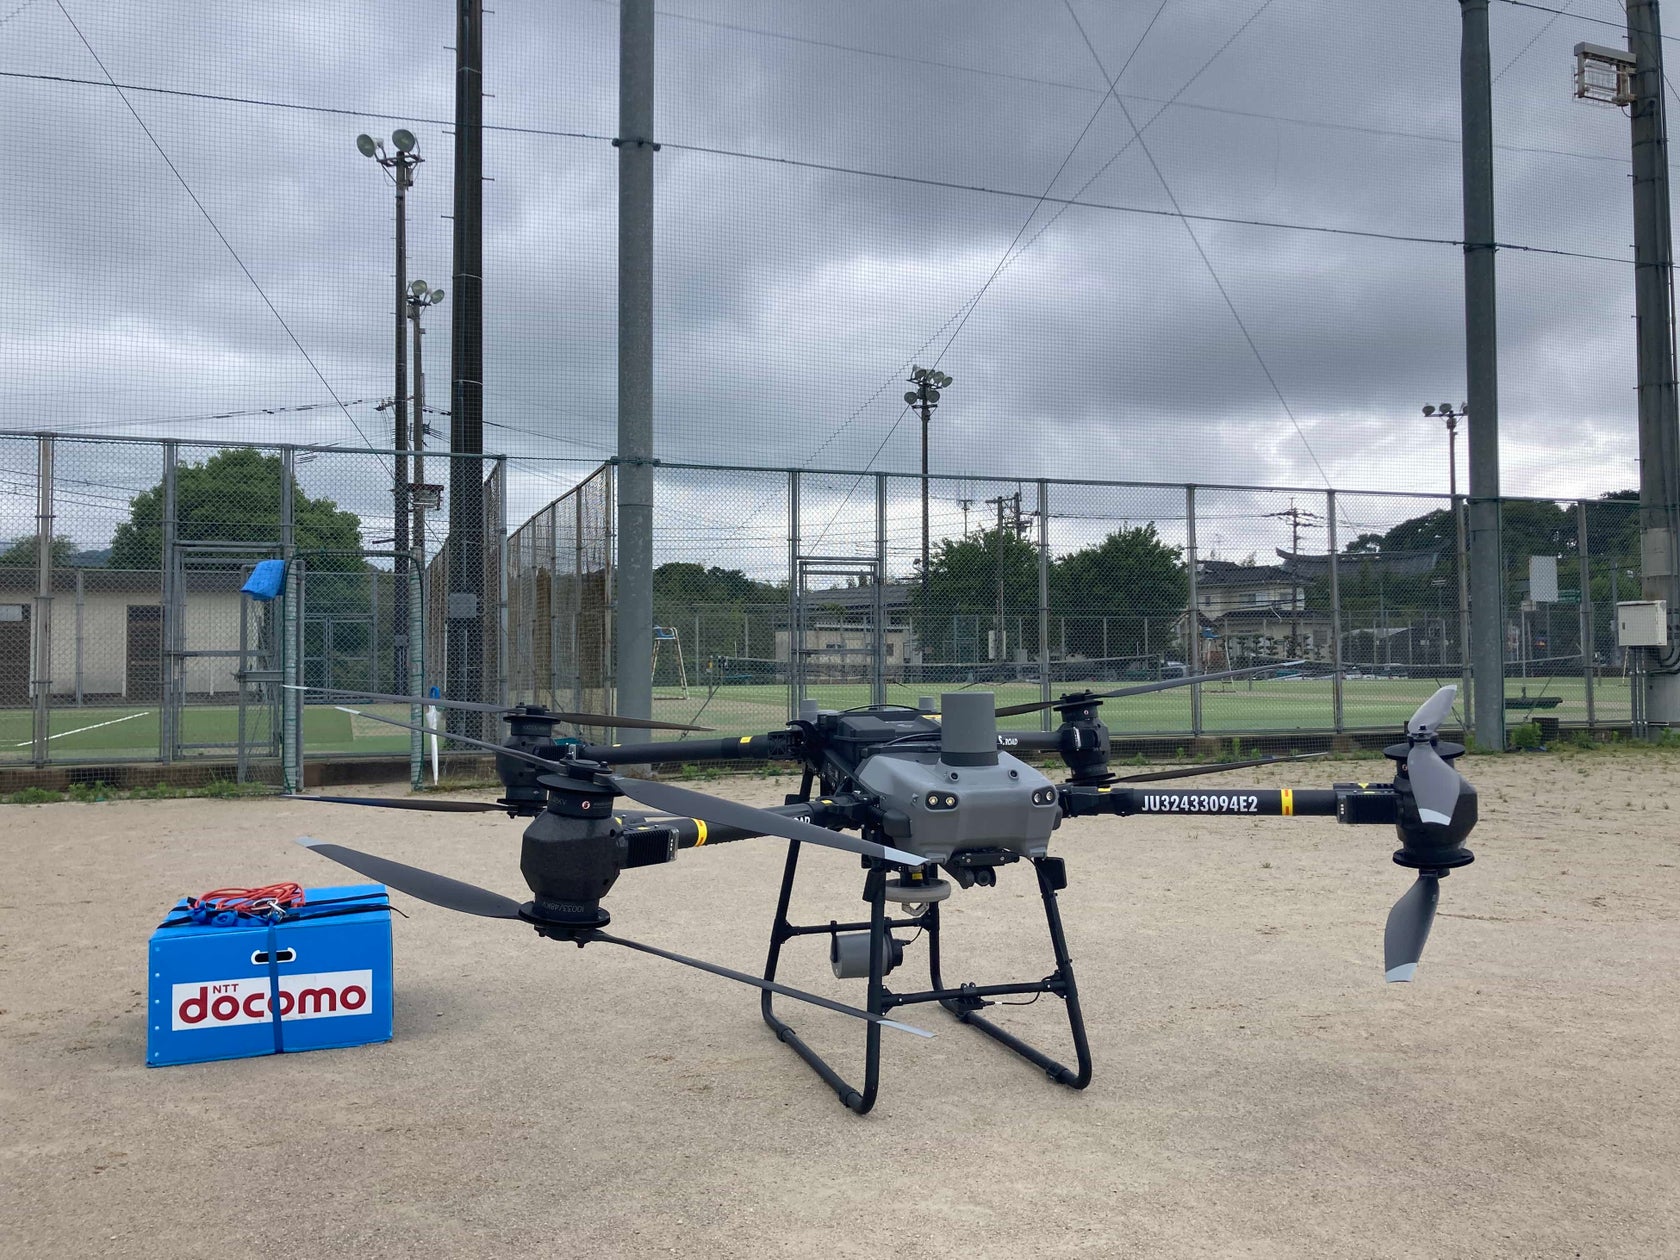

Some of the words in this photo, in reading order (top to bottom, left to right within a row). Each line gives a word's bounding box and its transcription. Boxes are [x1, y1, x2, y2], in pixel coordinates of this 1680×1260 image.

[1141, 795, 1258, 812] JU32433094E2
[212, 983, 239, 994] NTT
[178, 985, 367, 1024] docomo
